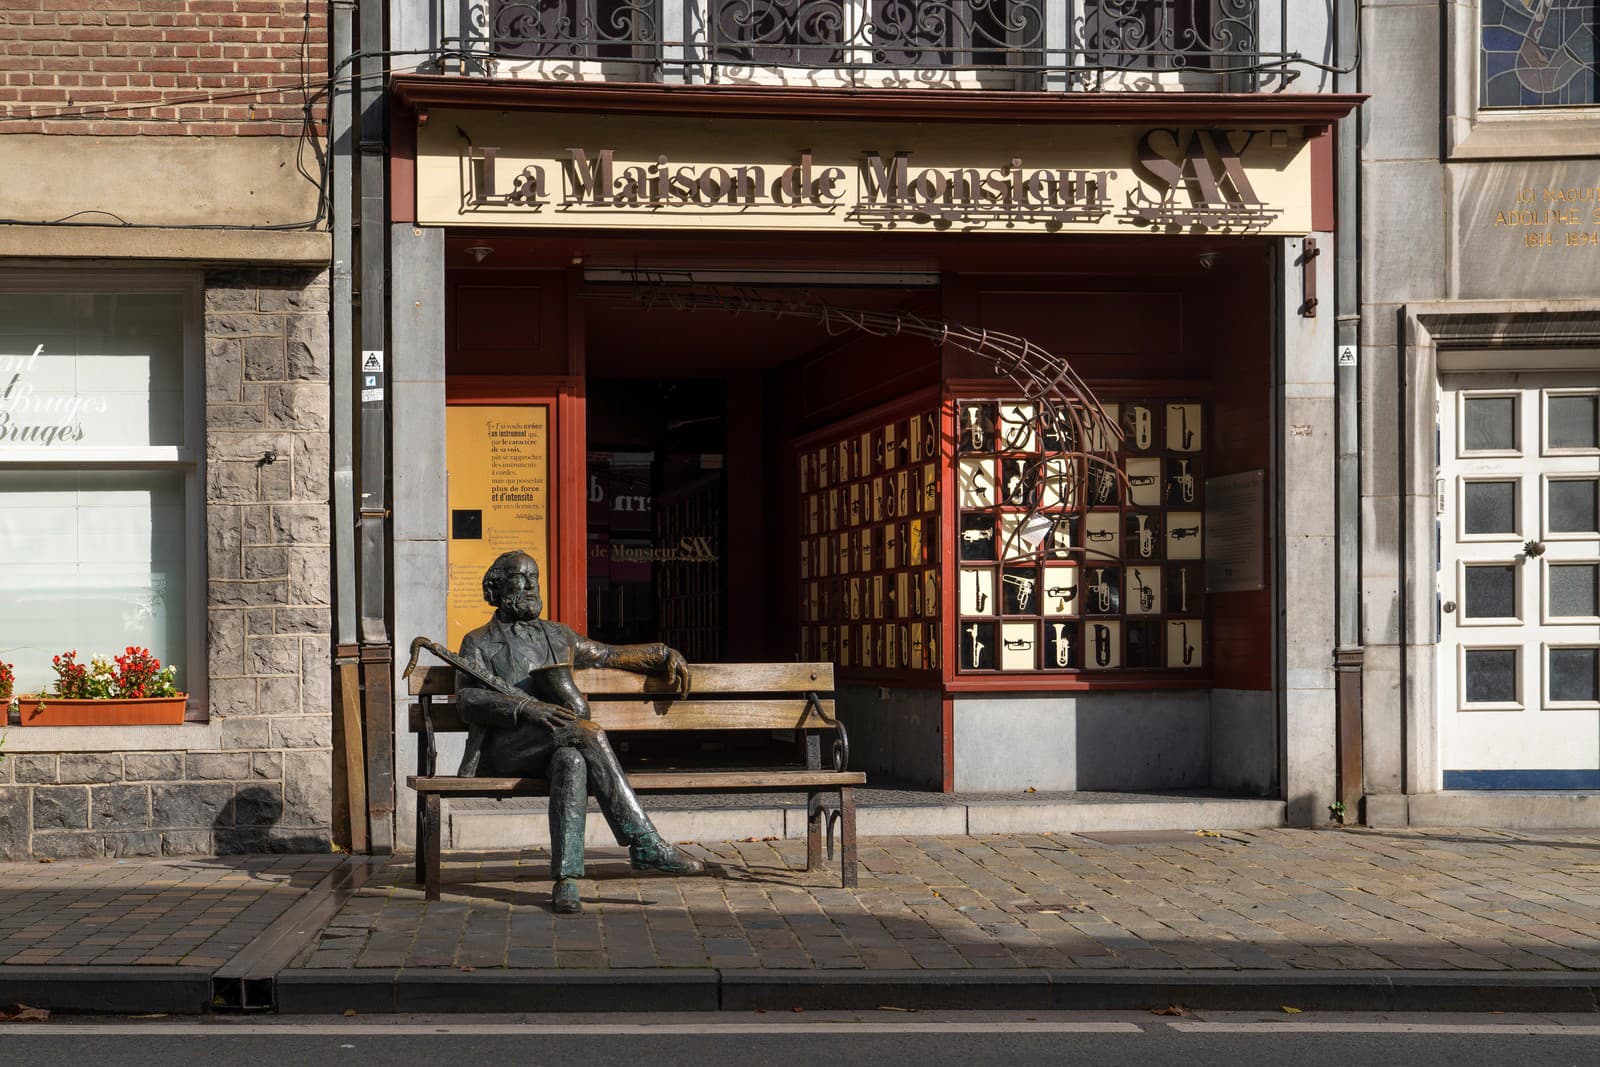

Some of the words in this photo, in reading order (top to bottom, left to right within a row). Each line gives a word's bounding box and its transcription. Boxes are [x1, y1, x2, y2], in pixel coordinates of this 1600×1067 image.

[478, 146, 551, 201] La
[565, 147, 770, 201] Maison
[780, 148, 847, 200] de
[861, 150, 1118, 206] Monsieur
[1136, 127, 1269, 206] SAX
[1516, 188, 1536, 203] ICI
[1494, 208, 1581, 226] ADOLPHE
[1524, 232, 1552, 247] 1814
[1565, 232, 1598, 247] 1894
[491, 485, 508, 493] plus
[491, 493, 498, 502] et
[500, 492, 534, 502] d'intensité
